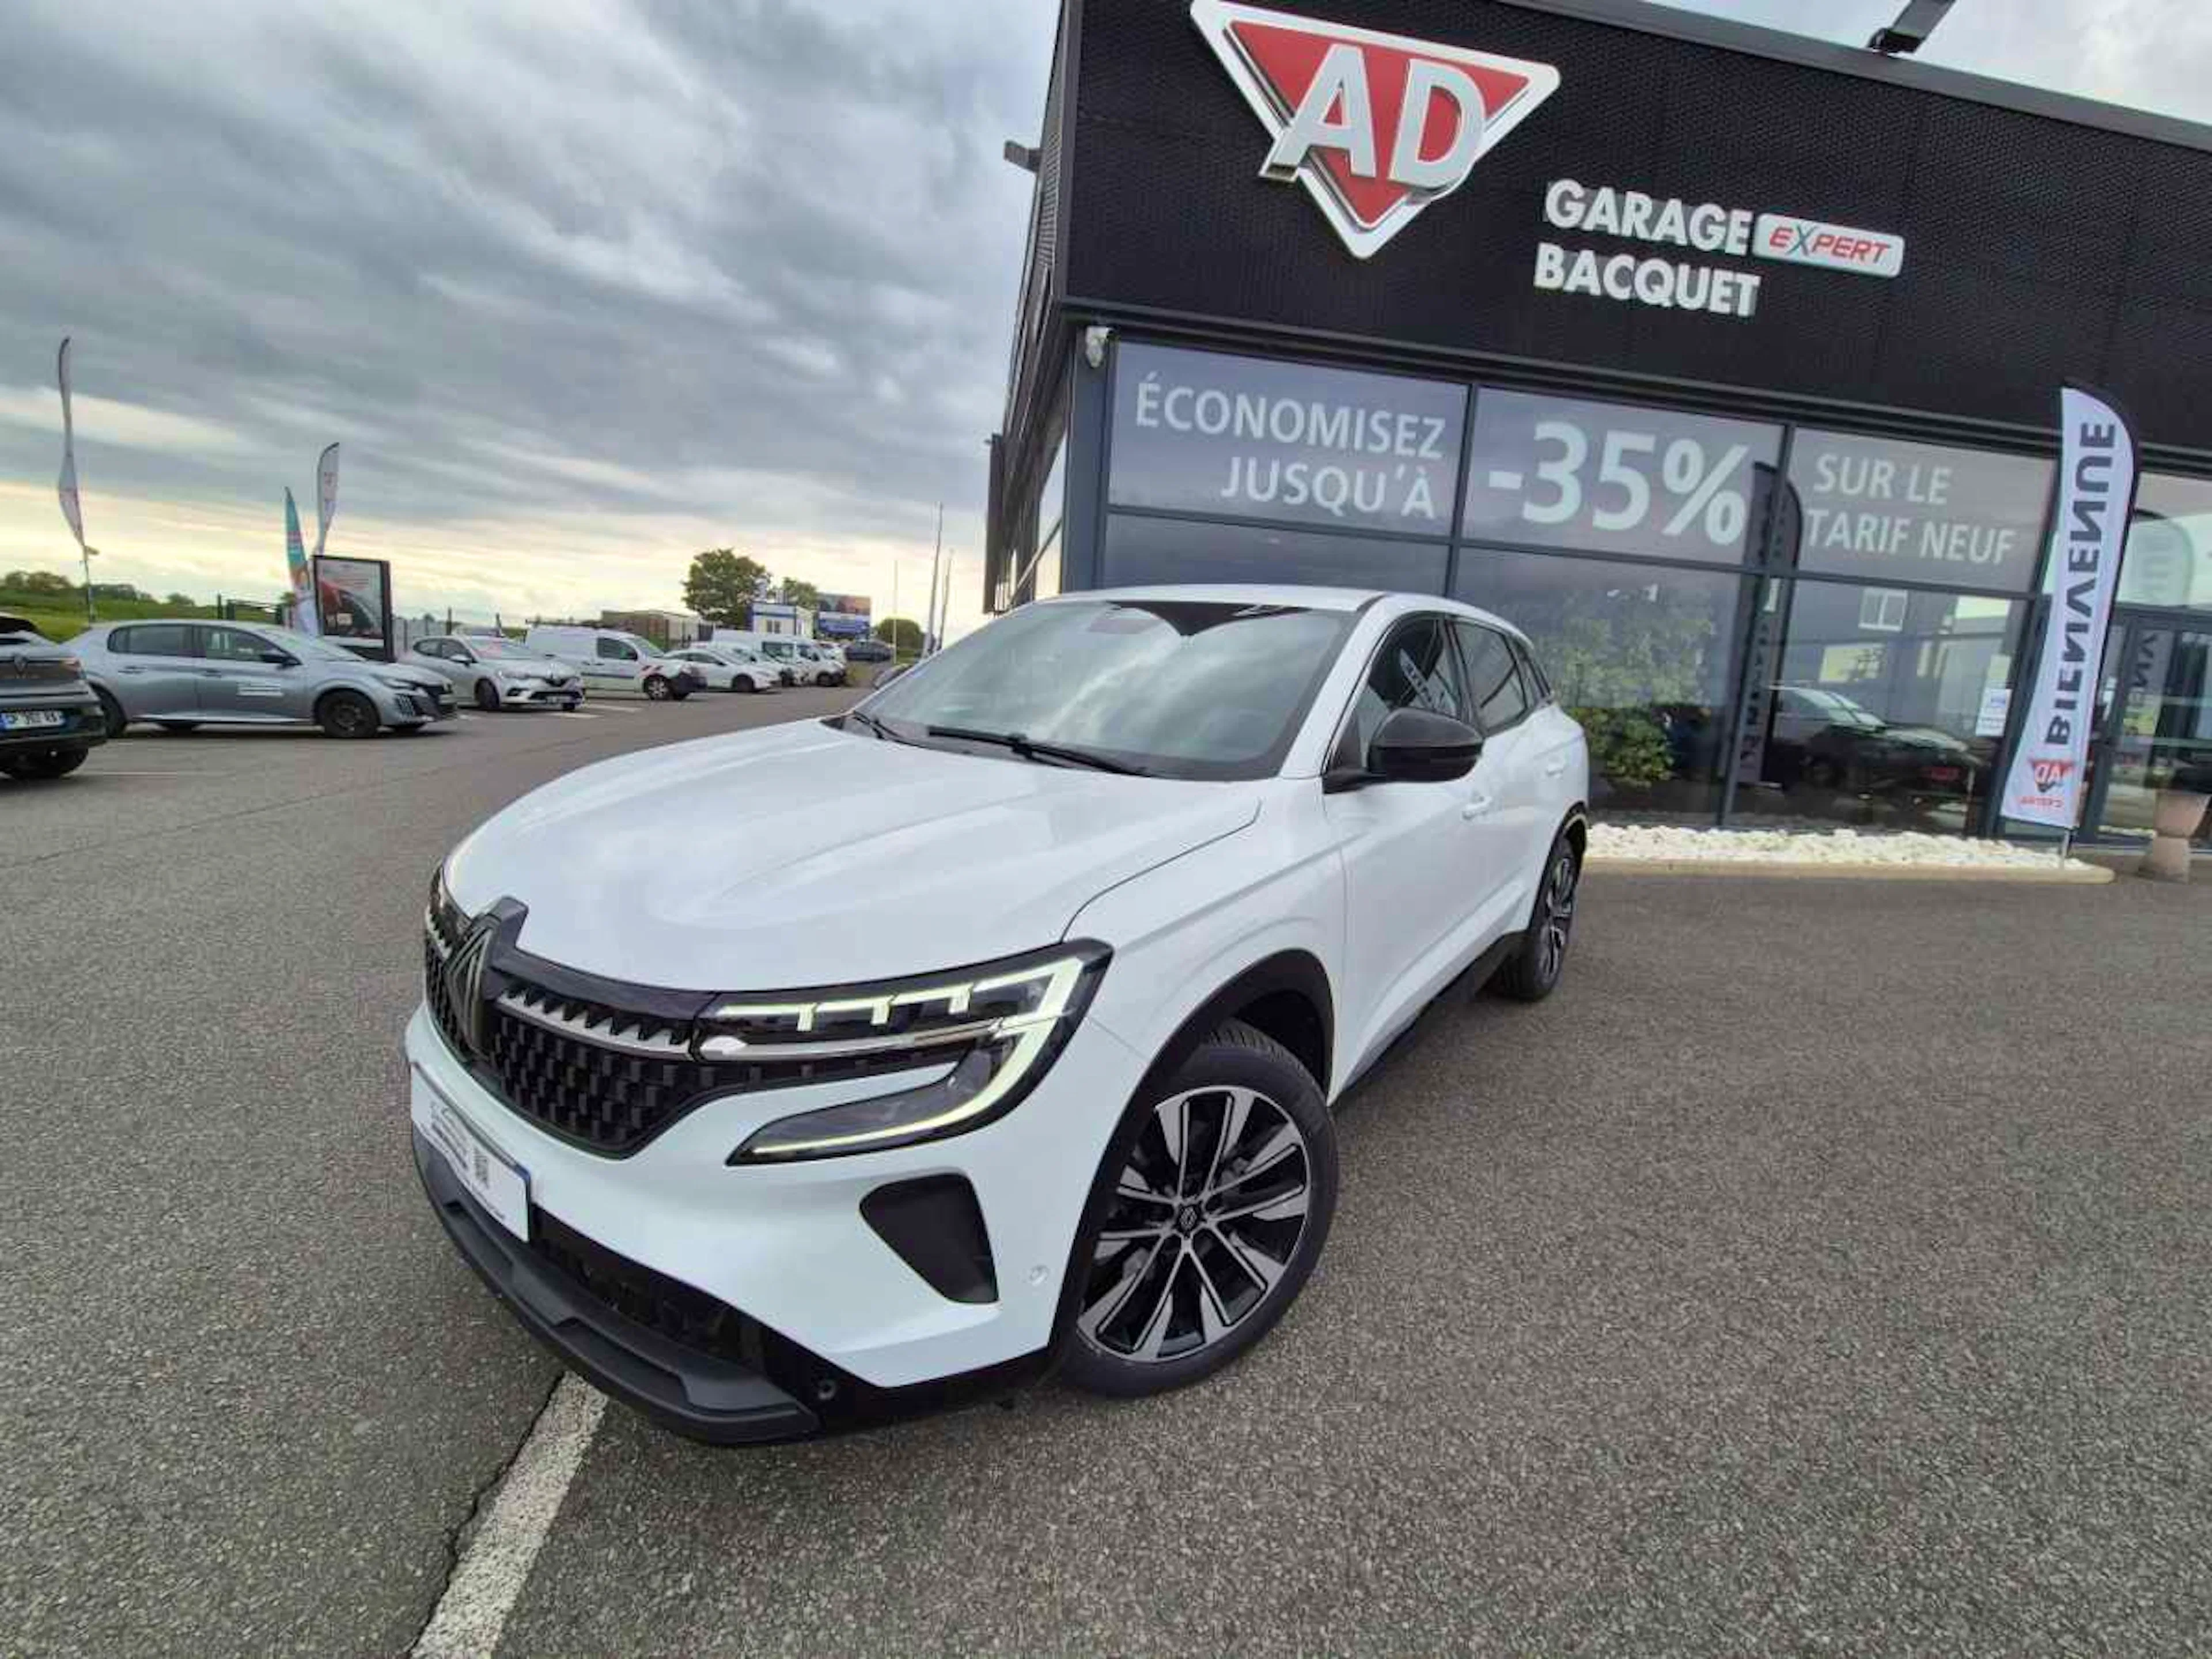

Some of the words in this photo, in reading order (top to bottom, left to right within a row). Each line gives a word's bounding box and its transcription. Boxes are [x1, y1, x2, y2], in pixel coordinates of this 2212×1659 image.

[1259, 42, 1487, 193] AD
[1544, 179, 1754, 256] GARAGE
[1533, 242, 1762, 317] BACQUET
[1136, 370, 1446, 460] ÉCONOMISEZ
[1221, 456, 1435, 519] JUSQU'À
[1488, 421, 1751, 546] -35%
[1814, 453, 1893, 498] SUR
[1908, 465, 1952, 506] LE
[1804, 508, 1911, 554] TARIF
[1921, 521, 2015, 566] NEUF
